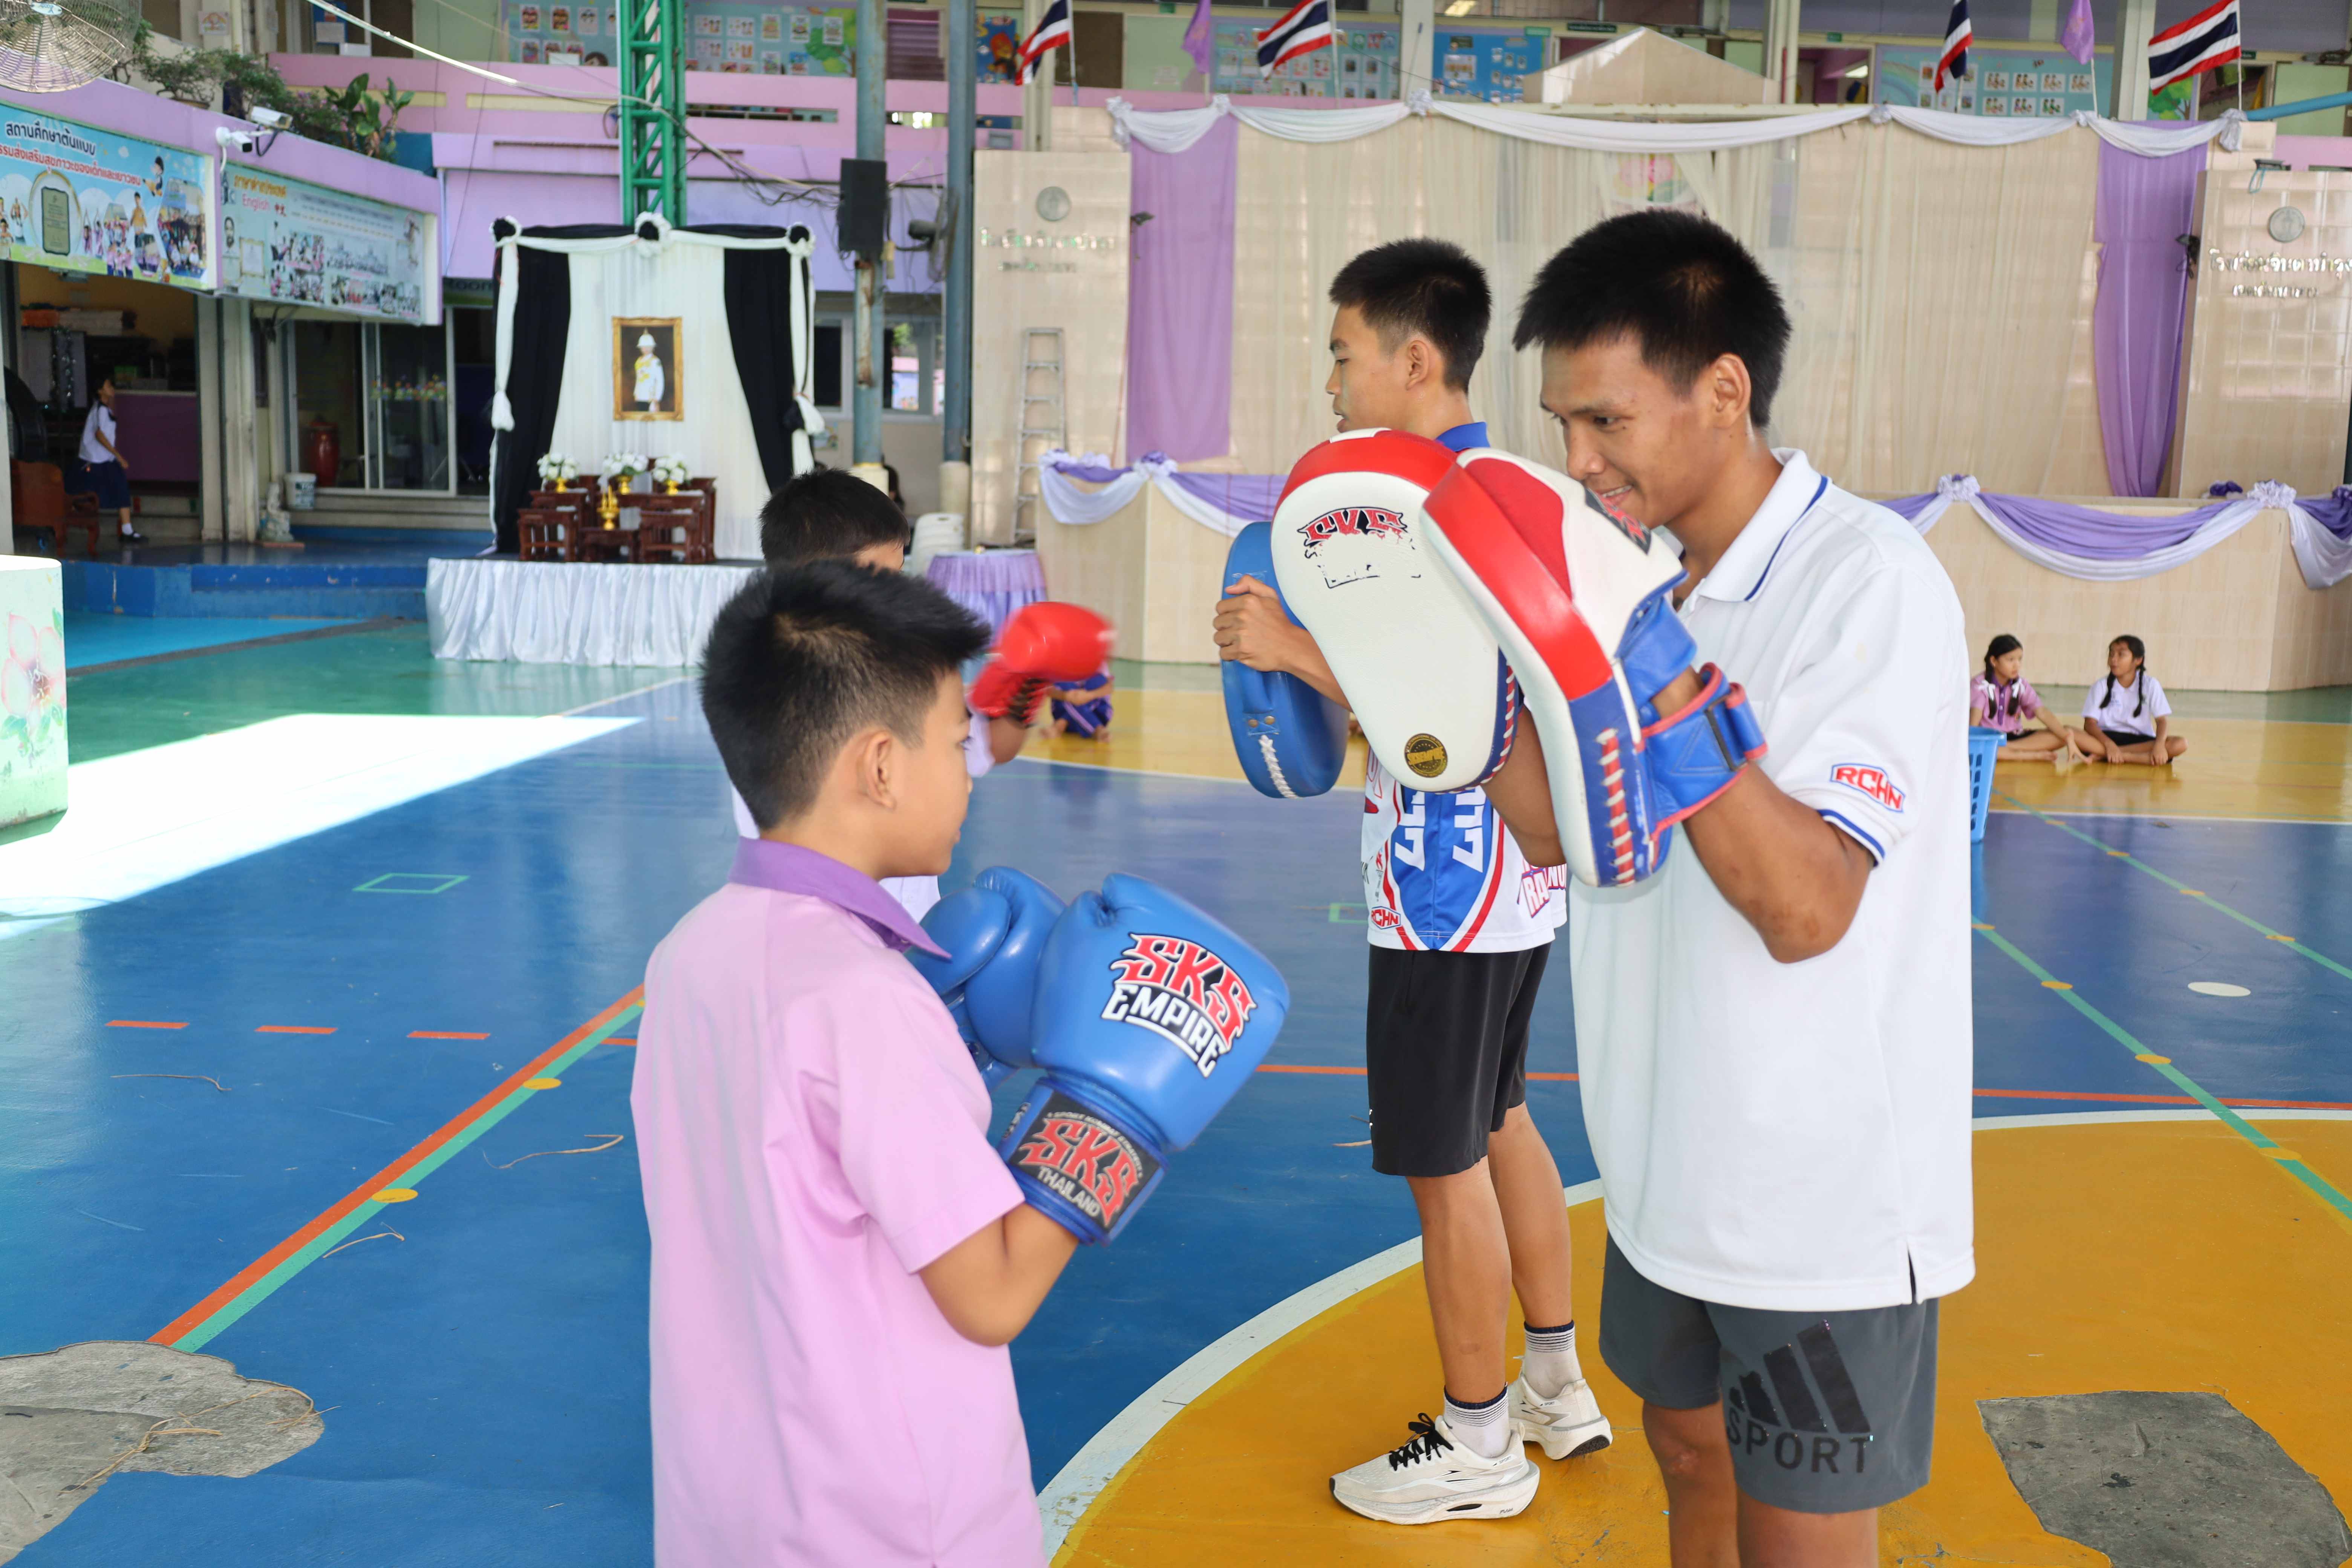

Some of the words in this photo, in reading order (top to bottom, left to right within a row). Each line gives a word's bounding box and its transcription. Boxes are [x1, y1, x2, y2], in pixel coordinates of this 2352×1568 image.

[6, 121, 95, 155] สถานศึกษาต้นแบบ
[242, 193, 269, 211] English
[1836, 767, 1902, 809] RCHN
[1109, 933, 1258, 1051] SKS
[1101, 983, 1228, 1078] EMPIRE
[1018, 1117, 1140, 1227] SKS
[1036, 1165, 1102, 1217] THAILAND
[1727, 1407, 1873, 1473] SPORT
